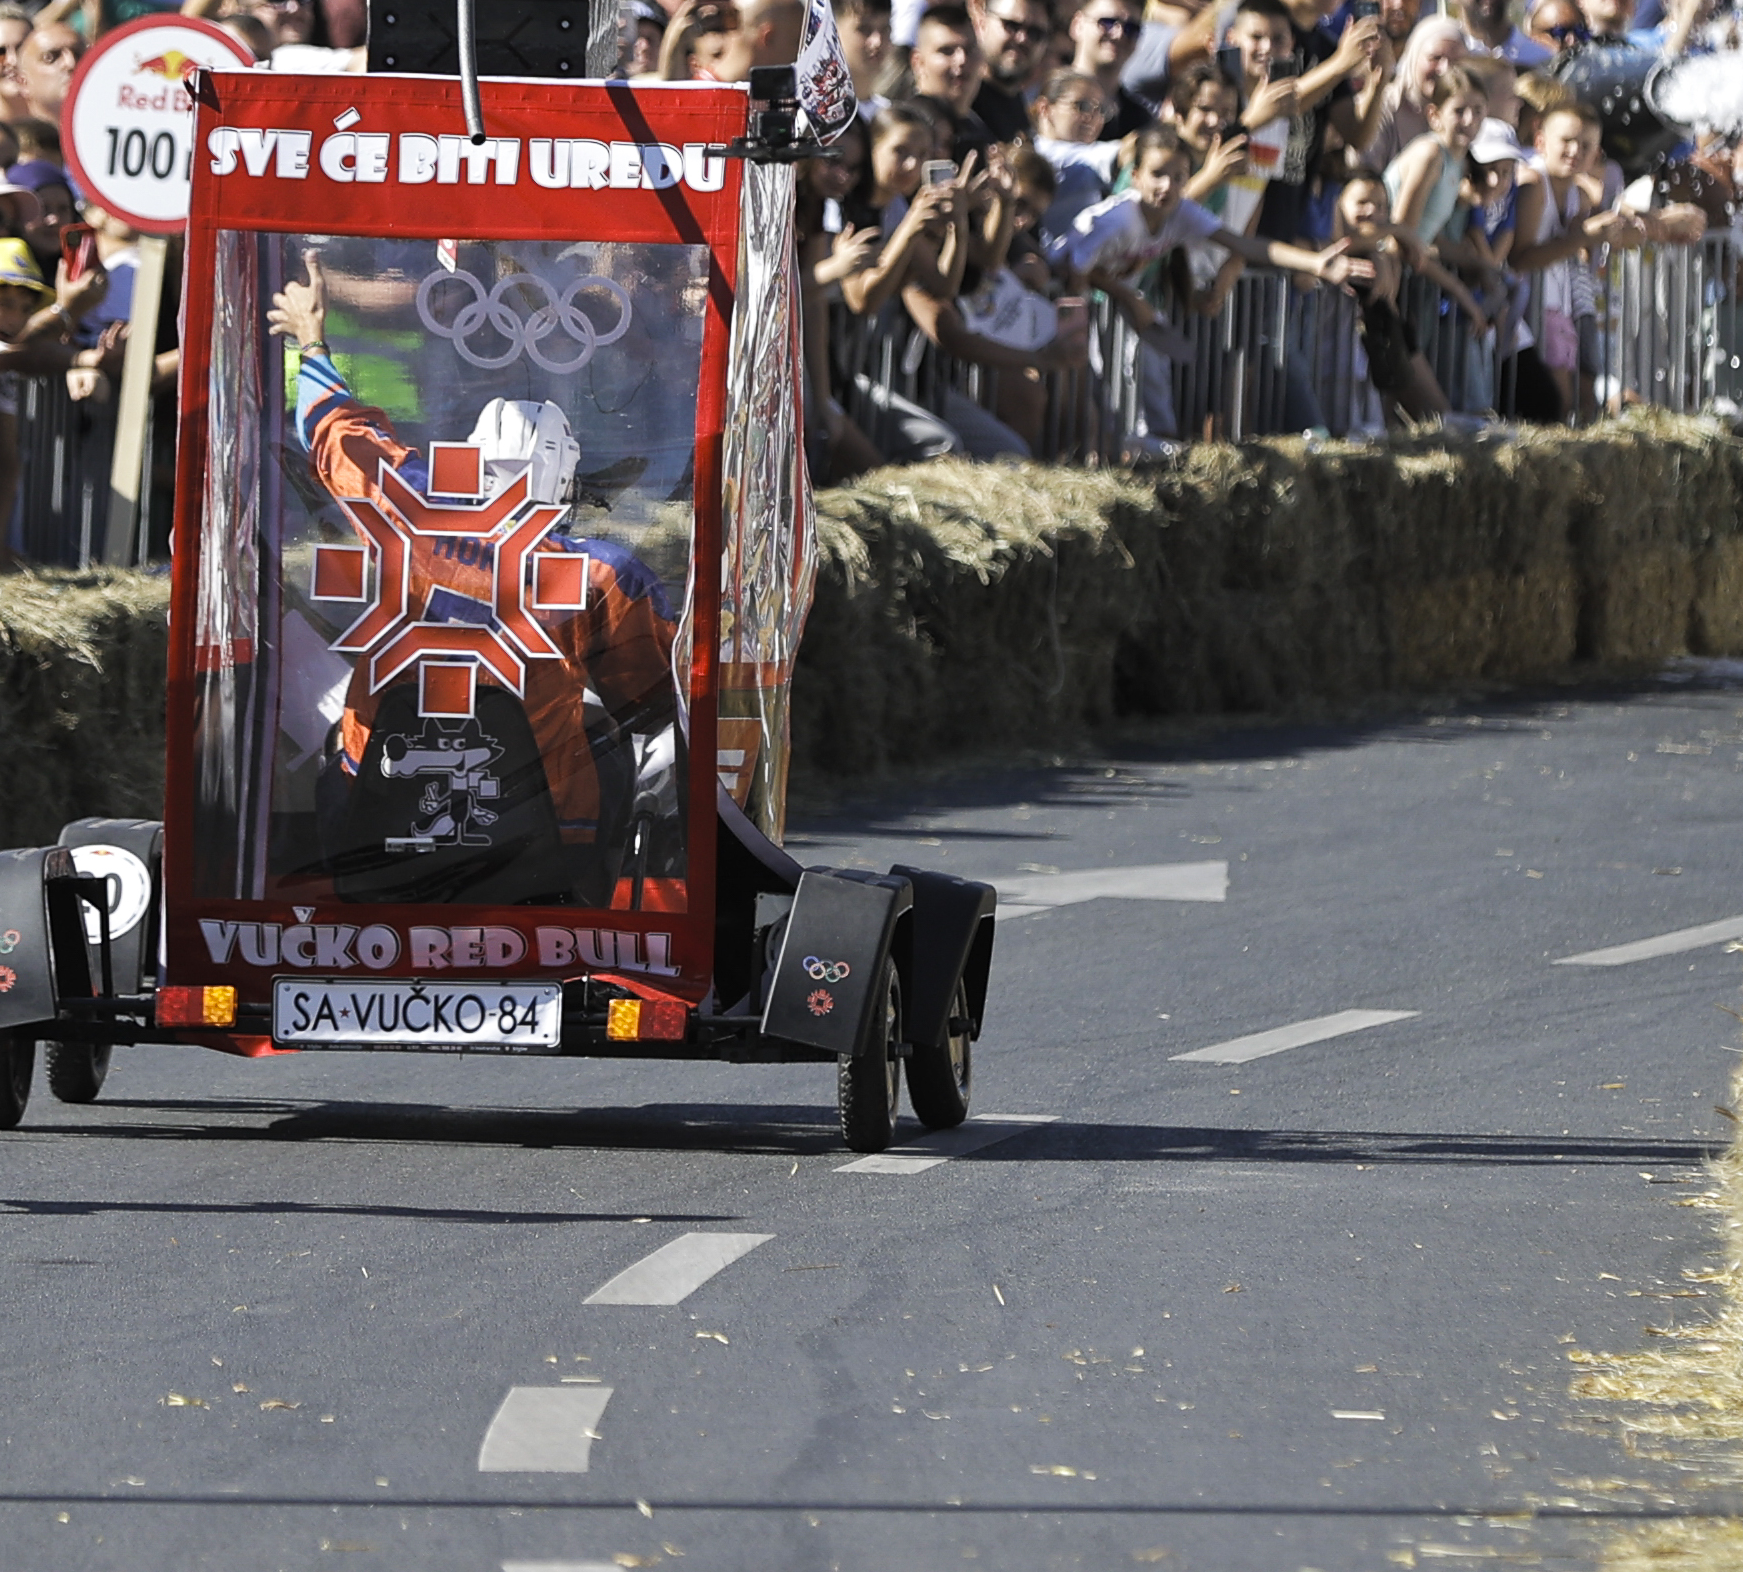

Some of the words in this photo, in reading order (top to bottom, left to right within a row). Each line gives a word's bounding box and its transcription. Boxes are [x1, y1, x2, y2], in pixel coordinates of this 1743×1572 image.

[118, 85, 168, 111] Red
[105, 126, 176, 180] 100
[207, 125, 312, 180] SVE
[319, 106, 391, 185] ĆE
[398, 131, 521, 186] BITI
[529, 136, 727, 193] UREDU
[199, 906, 402, 970] VUČKO
[408, 925, 529, 970] RED
[535, 925, 682, 977] BULL
